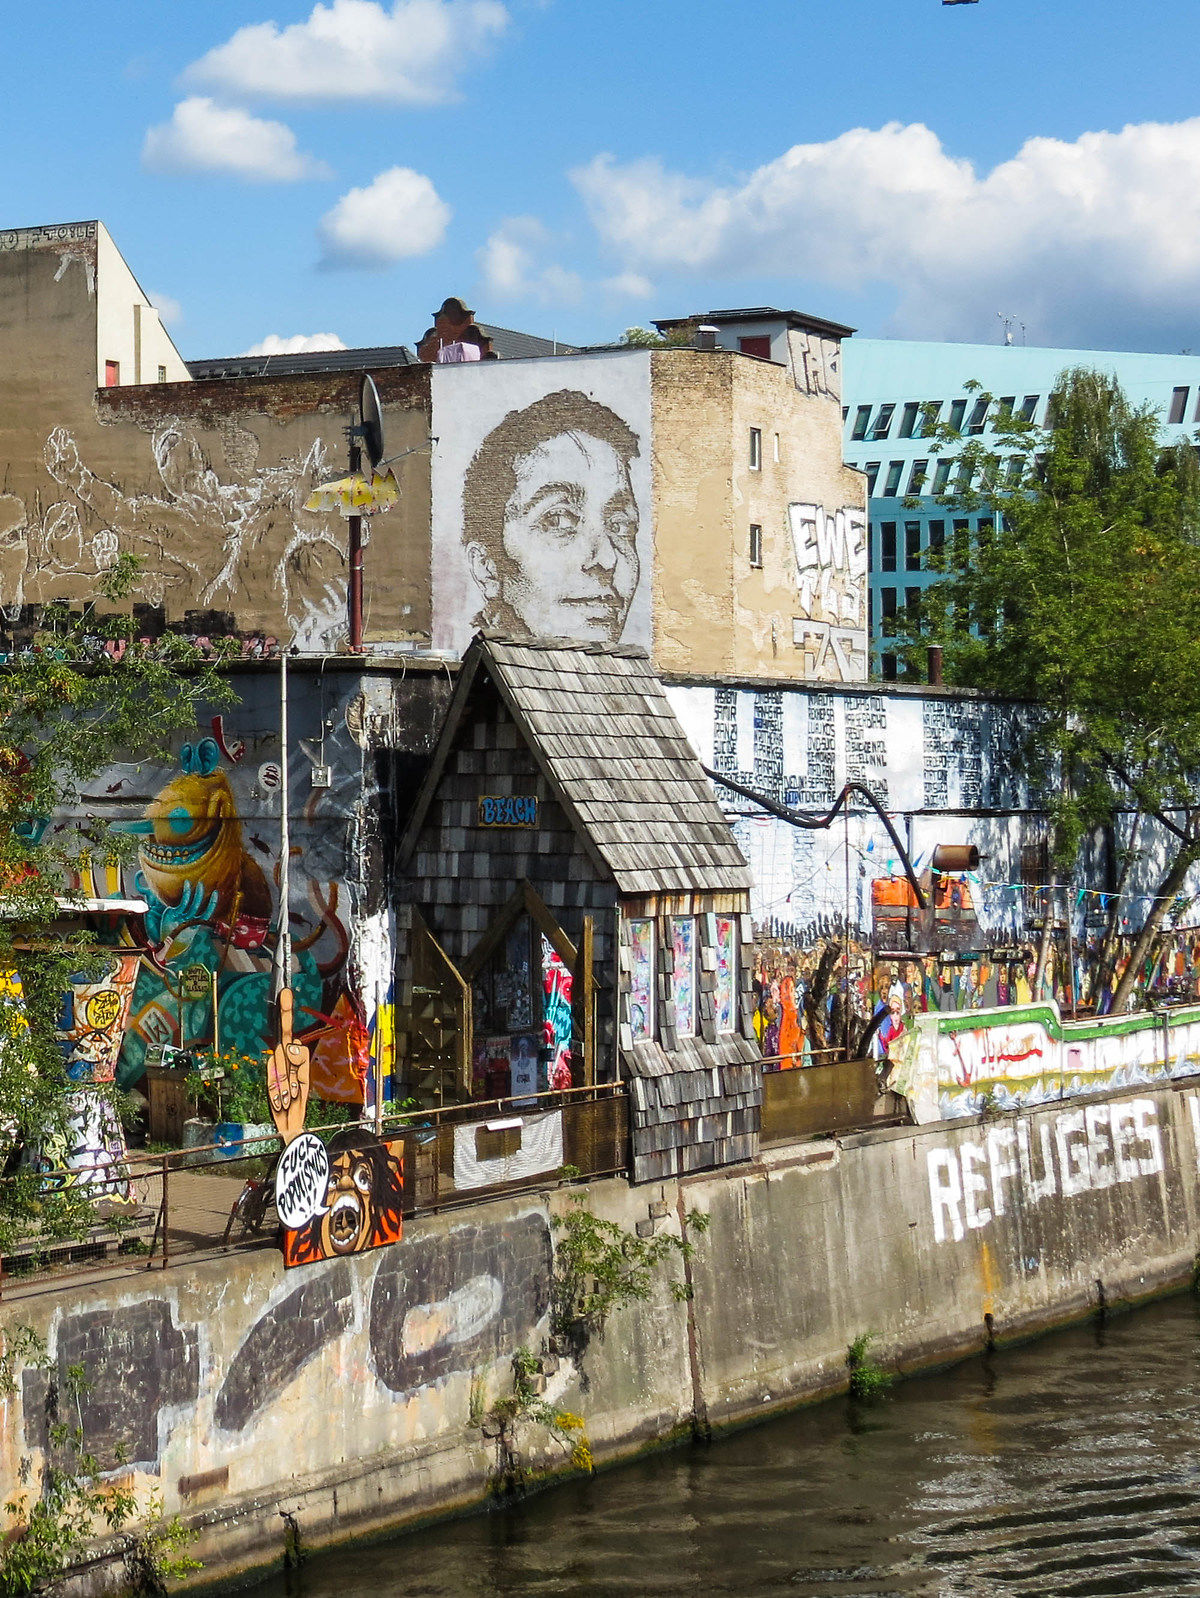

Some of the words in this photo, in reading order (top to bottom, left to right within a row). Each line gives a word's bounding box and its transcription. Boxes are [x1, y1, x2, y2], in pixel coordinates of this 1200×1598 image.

[482, 797, 536, 824] BEACH
[281, 1136, 318, 1184] FUCK
[927, 1099, 1164, 1243] REFUGEES
